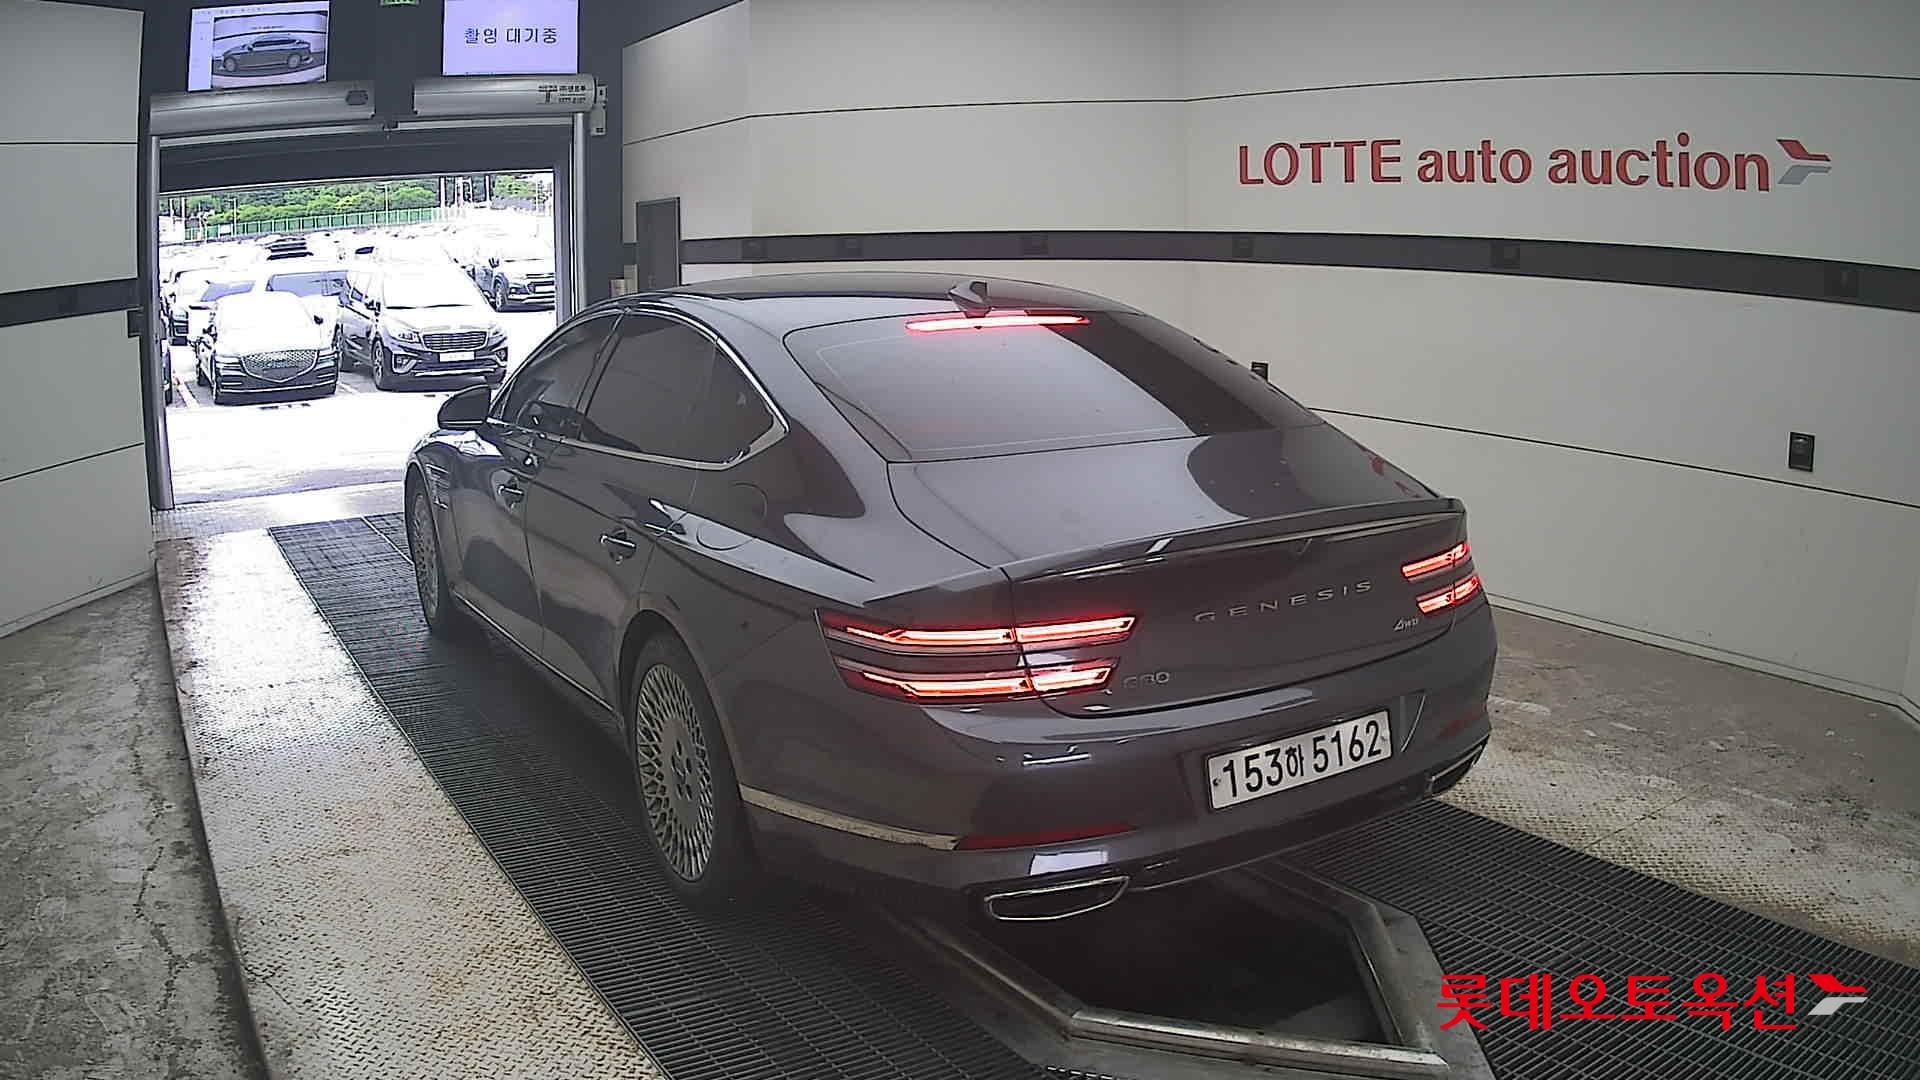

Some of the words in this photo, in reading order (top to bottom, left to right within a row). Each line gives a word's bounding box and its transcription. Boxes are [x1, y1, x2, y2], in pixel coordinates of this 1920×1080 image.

[464, 27, 498, 45] 촬영
[506, 27, 558, 45] 대기중
[1239, 139, 1401, 185] LOTTE
[1417, 140, 1532, 184] auto
[1548, 132, 1770, 192] auction
[1194, 579, 1372, 622] GENESIS
